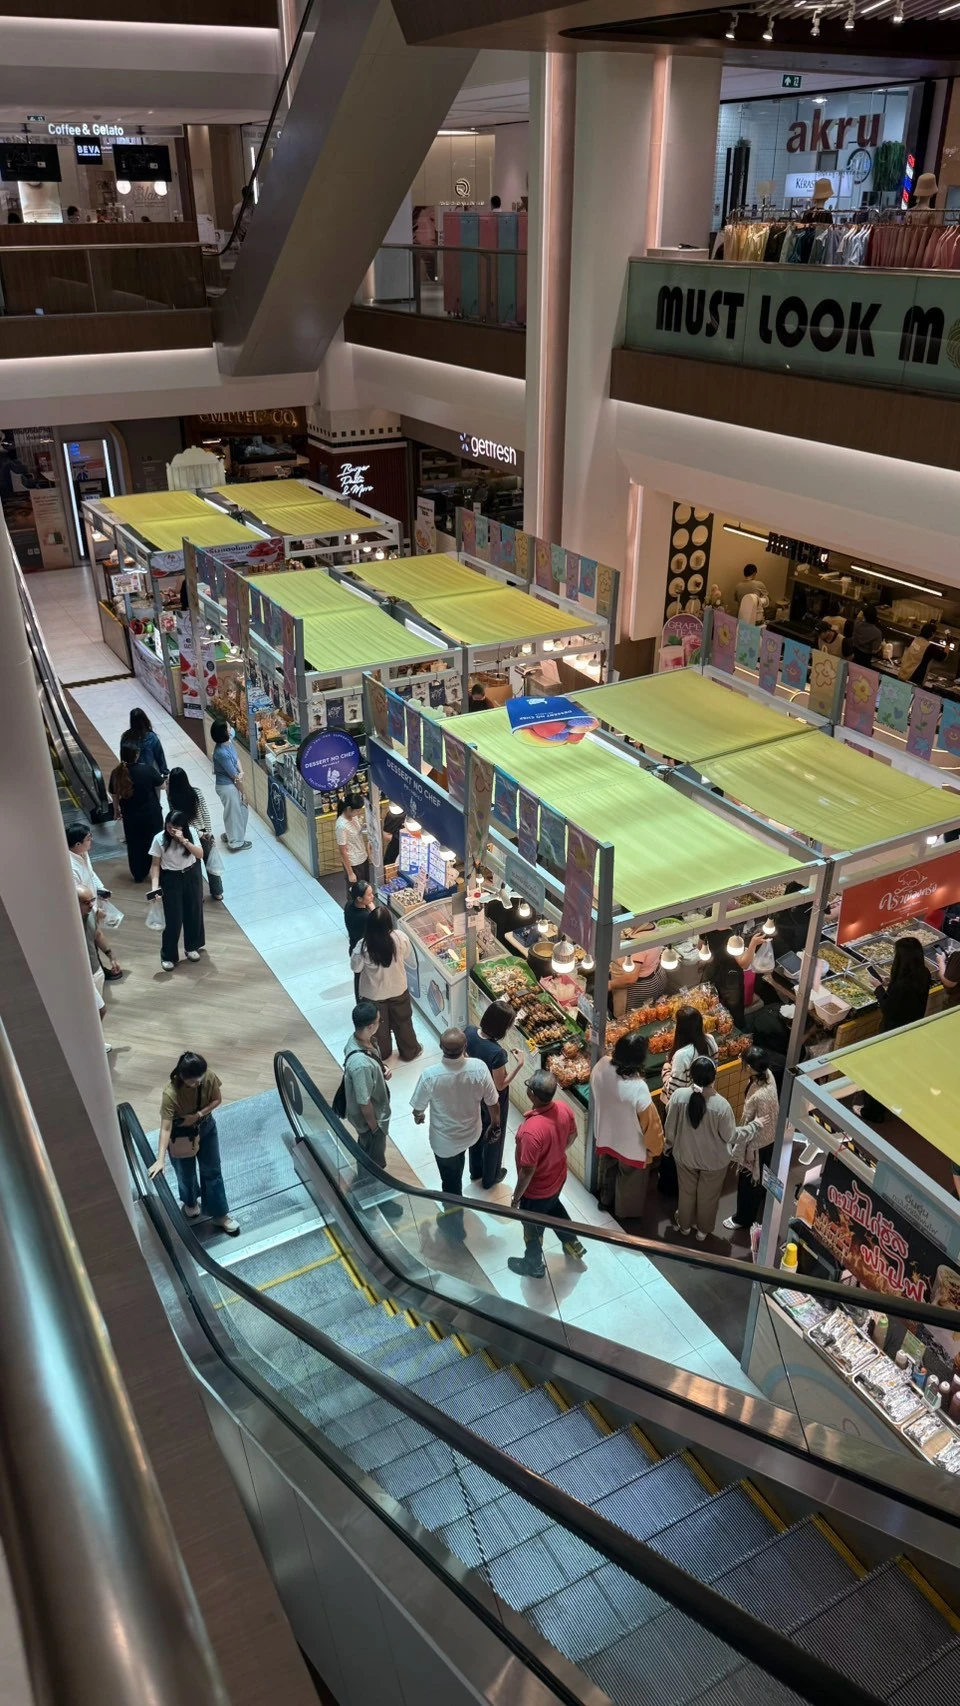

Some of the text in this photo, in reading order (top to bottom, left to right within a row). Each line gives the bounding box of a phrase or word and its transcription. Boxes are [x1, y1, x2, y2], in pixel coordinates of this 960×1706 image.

[48, 123, 124, 137] Coffee & Gelato
[786, 109, 881, 154] akru
[77, 145, 100, 154] BEVA
[795, 176, 816, 190] KÉRAS
[655, 284, 745, 340] MUST
[758, 295, 882, 358] LOOK
[337, 463, 371, 478] Burger
[341, 485, 374, 497] & More
[667, 620, 702, 631] GRAPE
[675, 629, 693, 637] TEA
[304, 757, 330, 769] DESSERT
[330, 755, 339, 763] NO
[340, 750, 355, 760] CHEF
[386, 758, 413, 785] DESSERT
[413, 779, 423, 794] NO
[423, 789, 442, 808] CHEF
